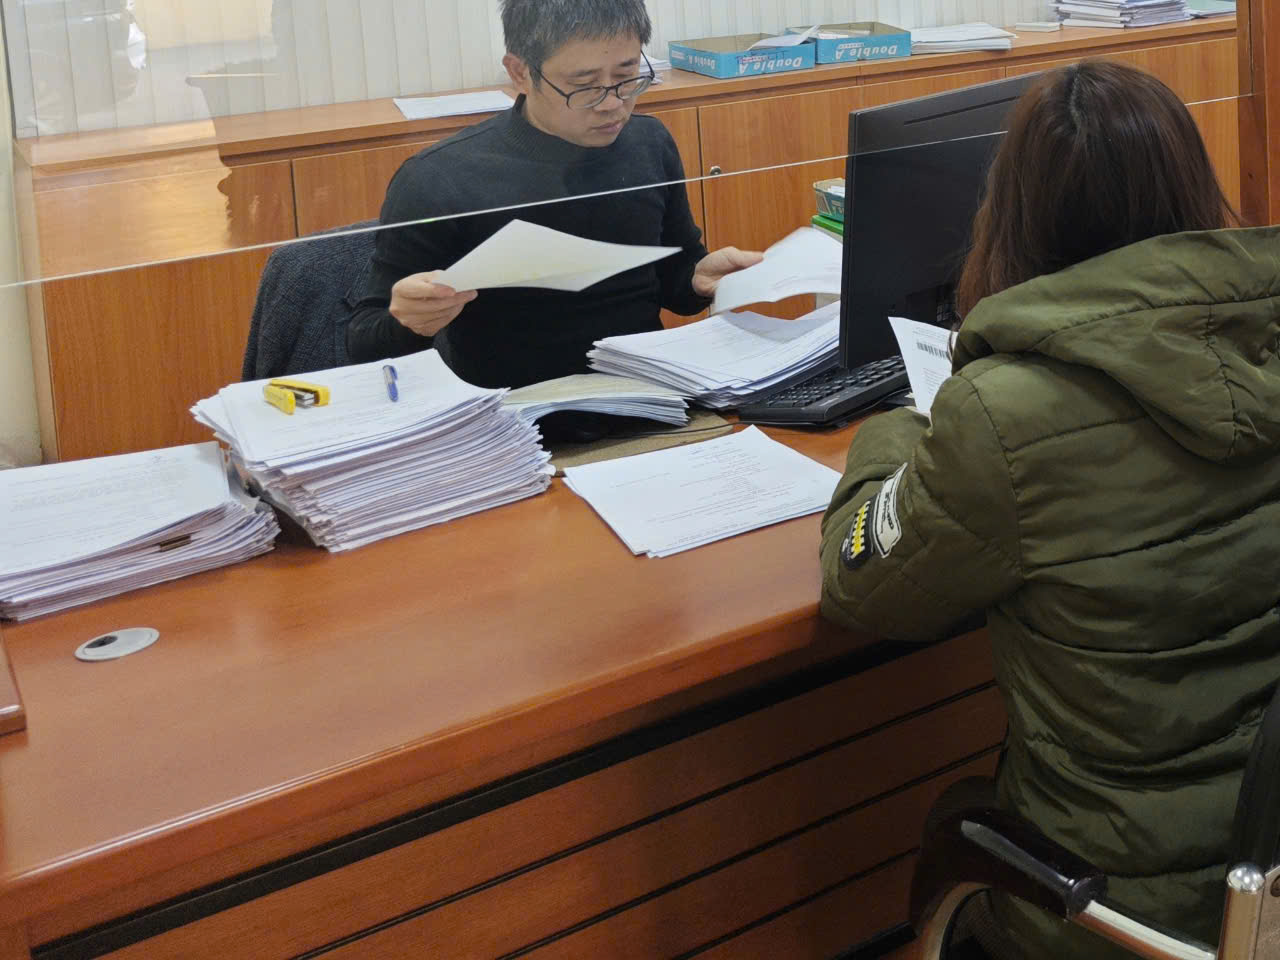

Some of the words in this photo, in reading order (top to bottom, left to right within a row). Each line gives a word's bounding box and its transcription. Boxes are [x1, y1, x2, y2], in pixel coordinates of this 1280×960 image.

[834, 50, 844, 60] A
[849, 44, 898, 58] Double
[754, 56, 803, 71] Double
